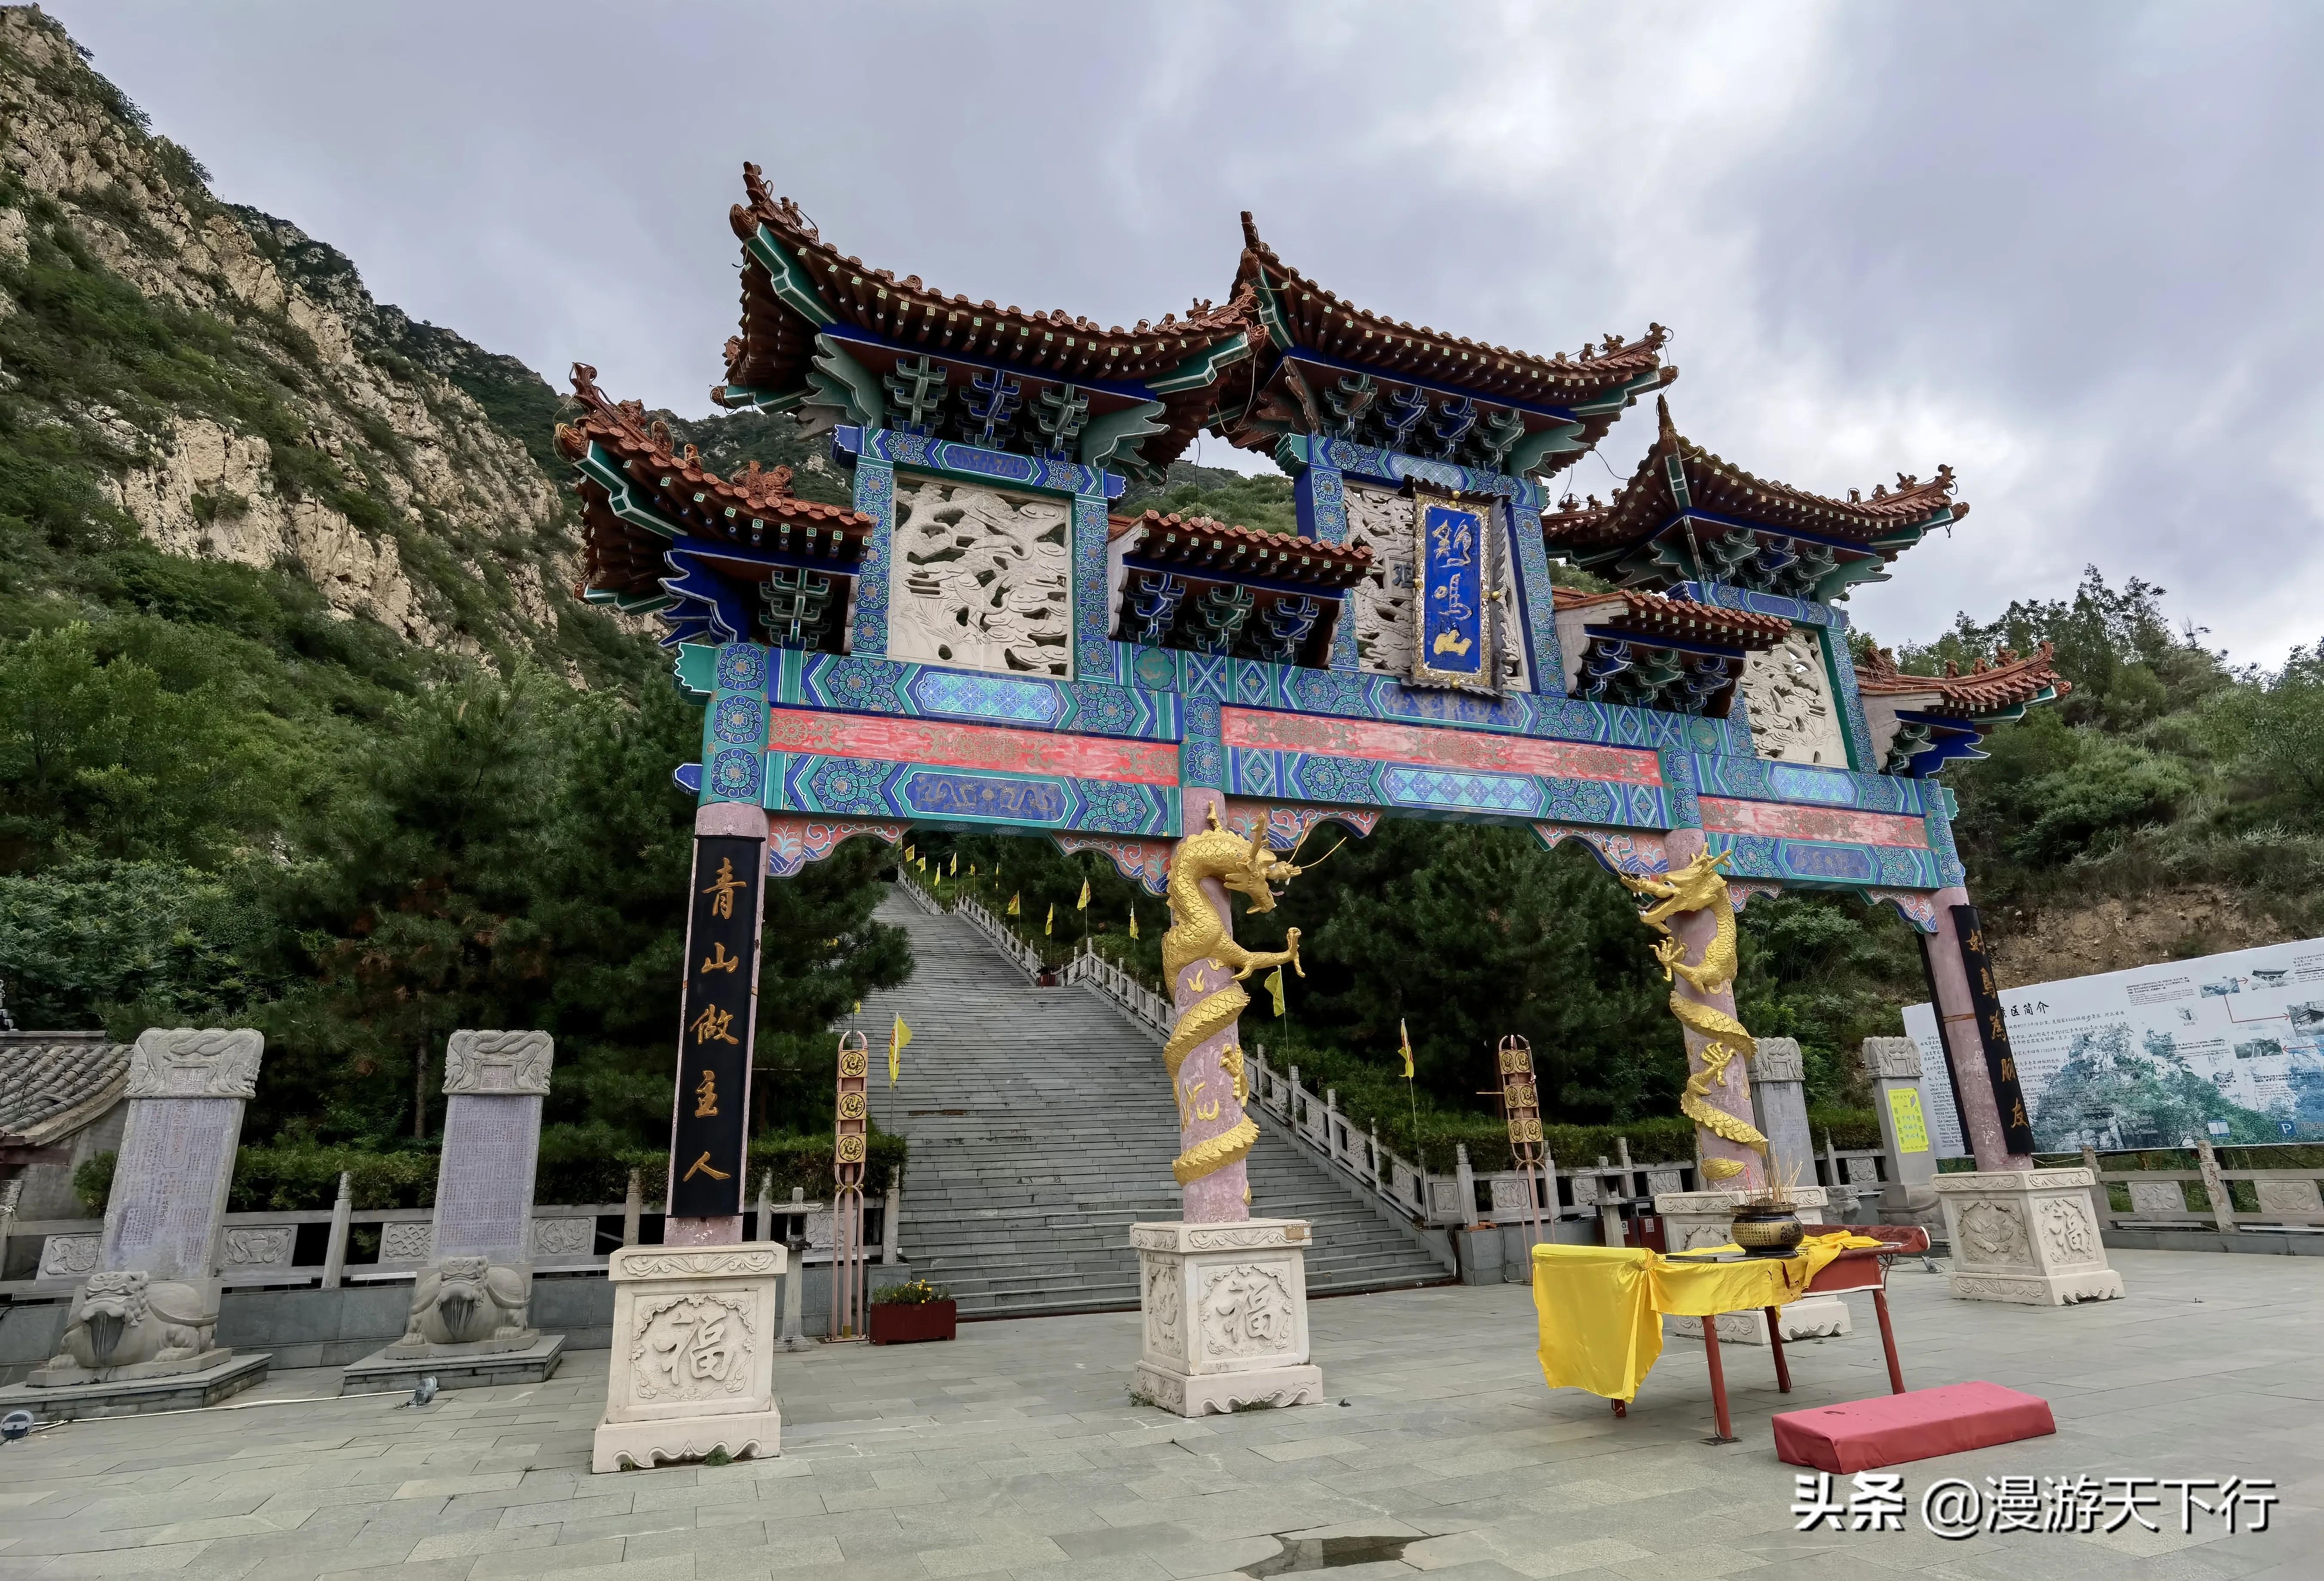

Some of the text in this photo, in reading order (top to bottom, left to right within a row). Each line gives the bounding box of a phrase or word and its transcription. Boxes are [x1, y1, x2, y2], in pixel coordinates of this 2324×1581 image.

[683, 857, 747, 1182] 青山做主人
[2281, 1123, 2292, 1134] P
[1215, 1277, 1277, 1344] 福
[652, 1308, 734, 1386] 福
